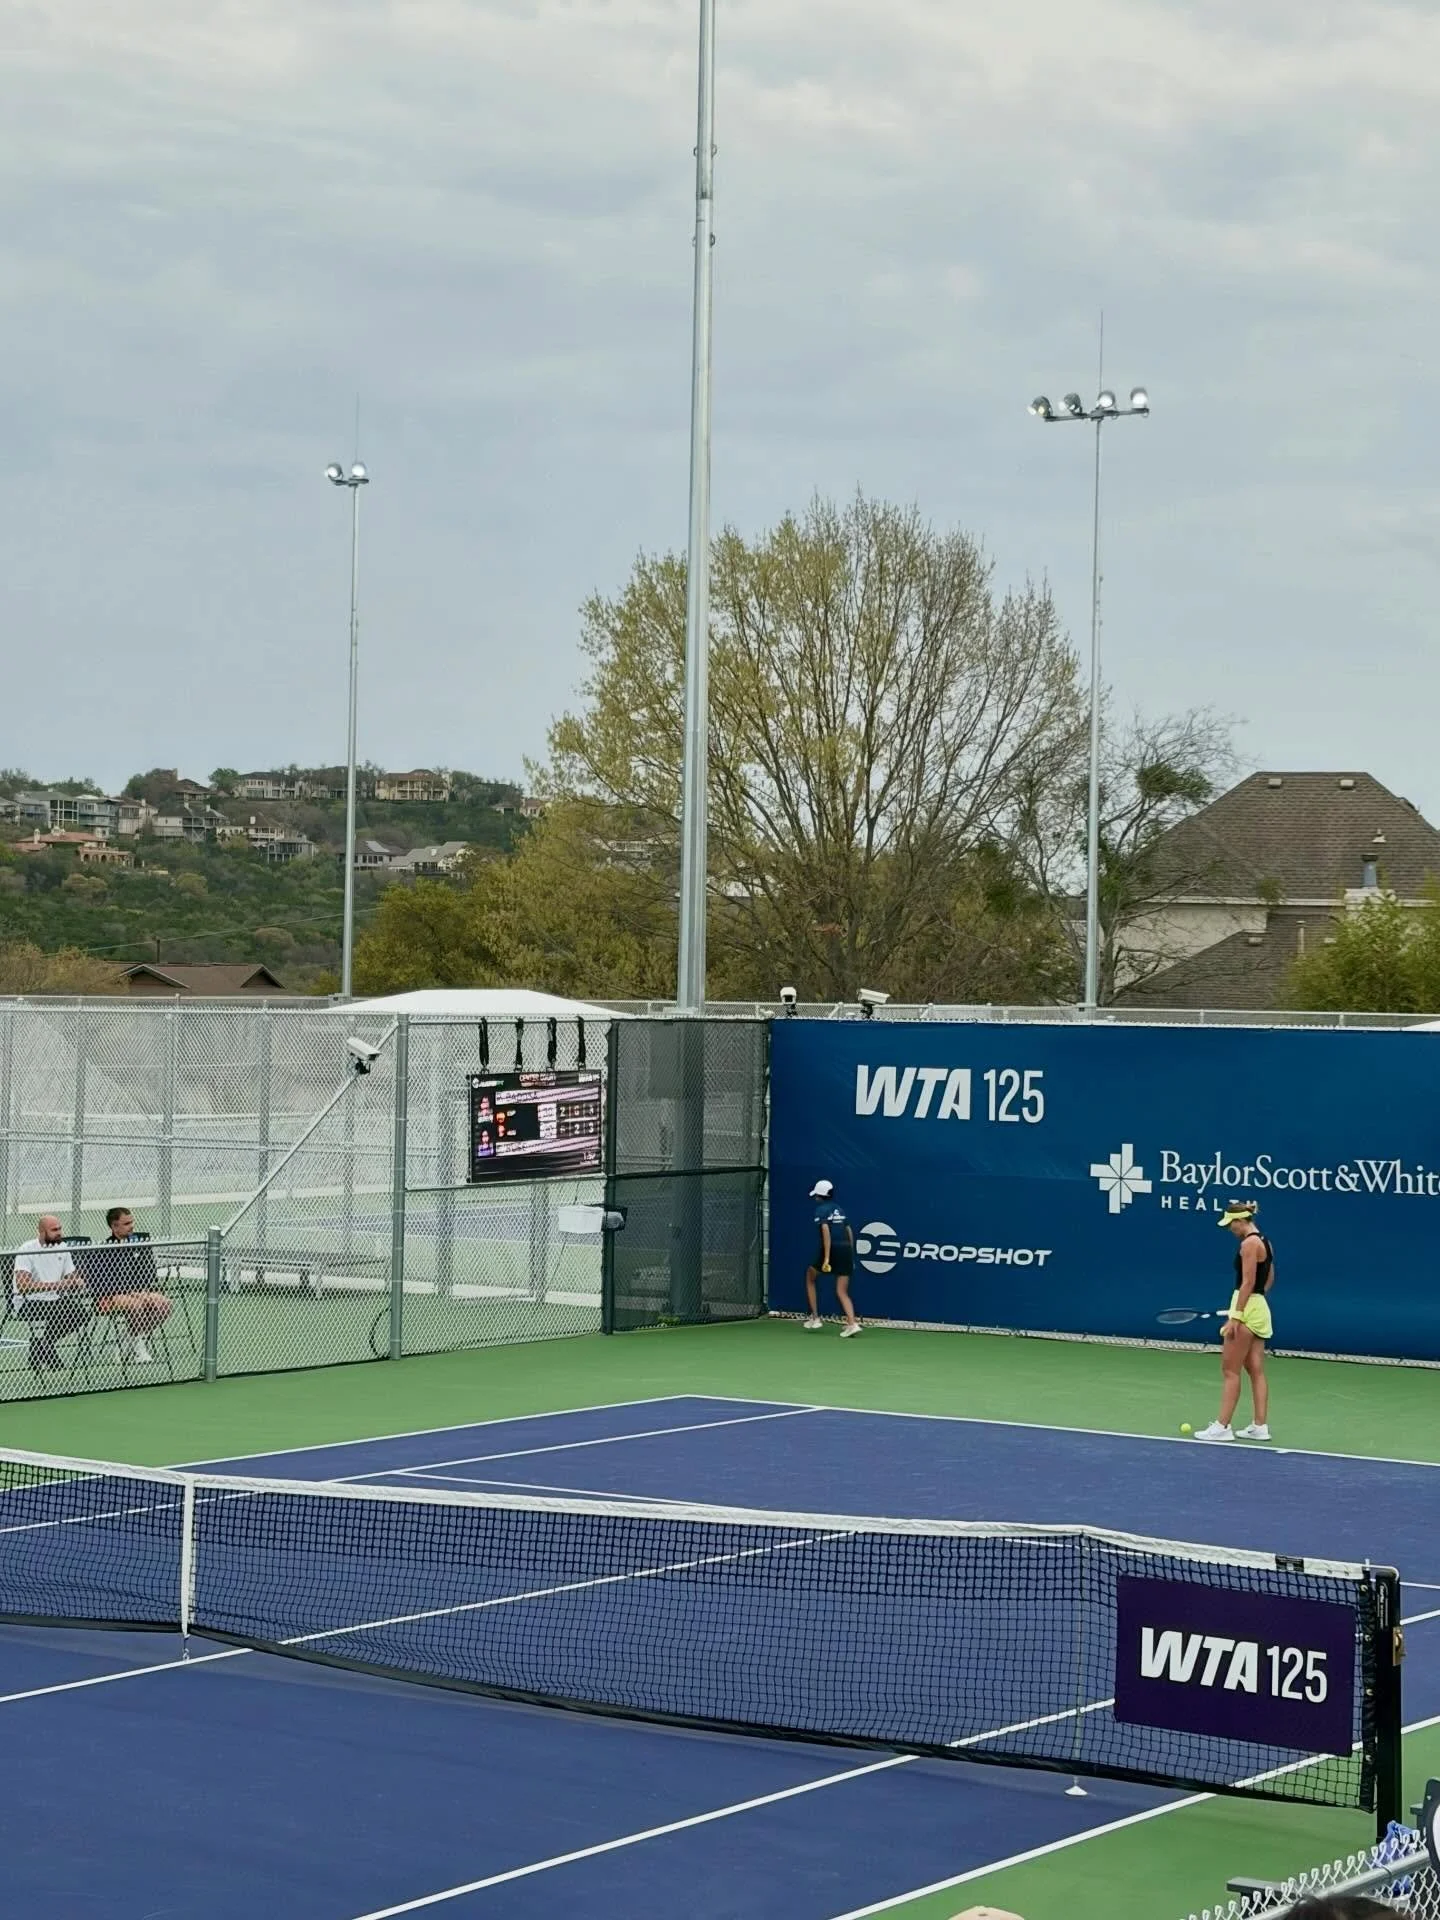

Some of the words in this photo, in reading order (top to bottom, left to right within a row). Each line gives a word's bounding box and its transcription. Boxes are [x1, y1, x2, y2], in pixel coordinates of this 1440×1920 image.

[855, 1064, 971, 1120] WTA
[983, 1068, 1045, 1124] 125
[1160, 1150, 1440, 1195] BaylorScott&Whit
[903, 1242, 1052, 1267] DROPSHOT
[1140, 1626, 1258, 1693] WTA
[1266, 1645, 1328, 1704] 125
